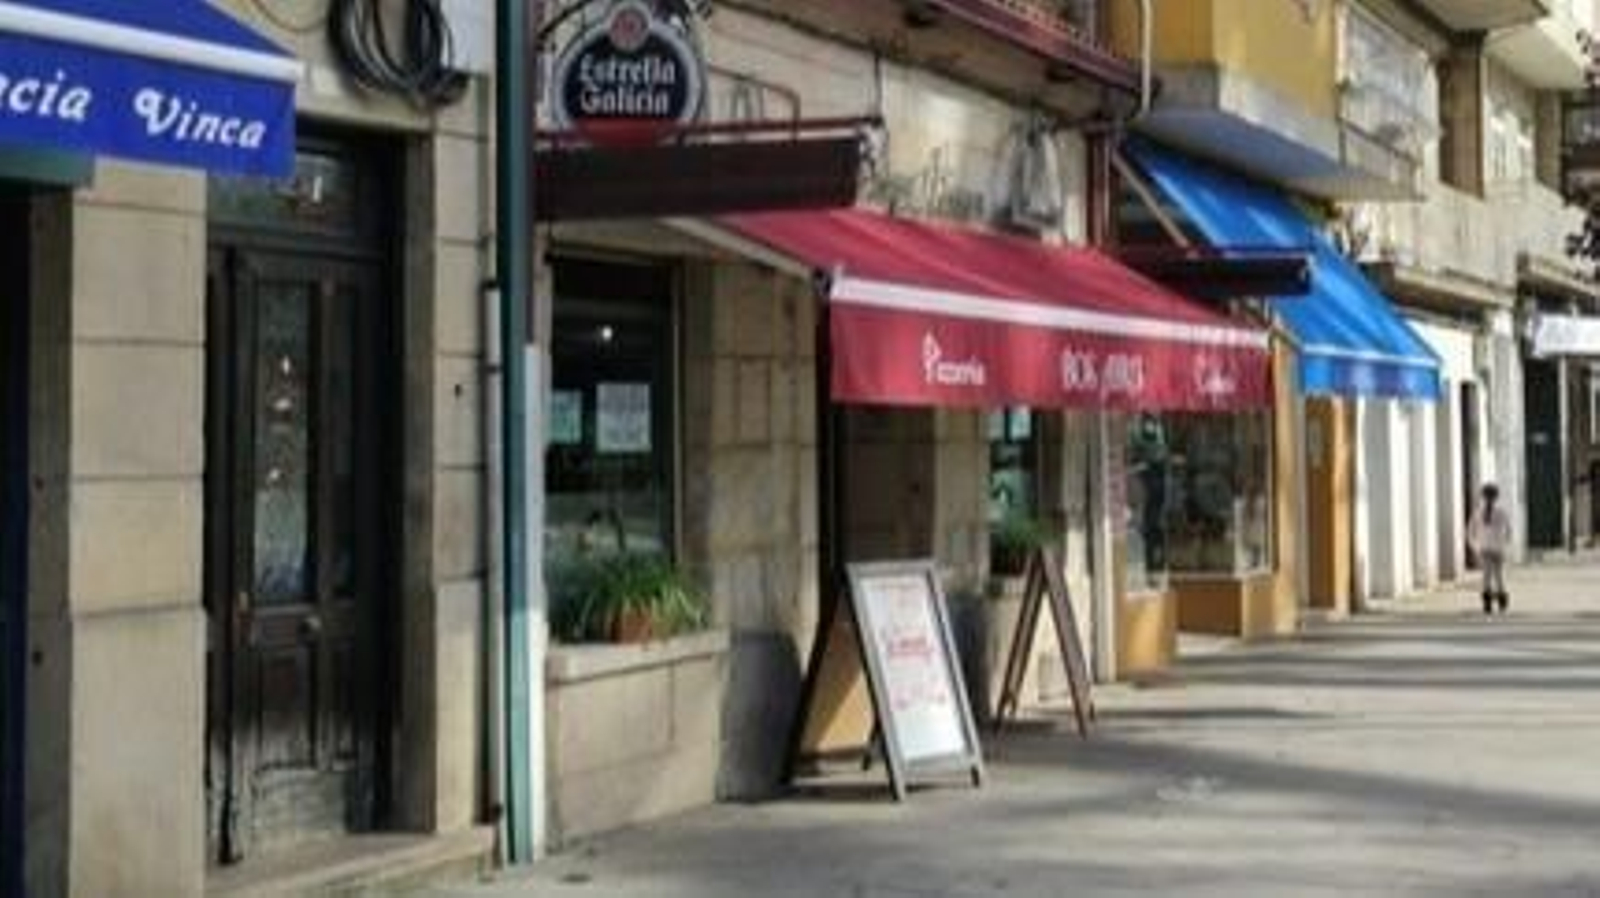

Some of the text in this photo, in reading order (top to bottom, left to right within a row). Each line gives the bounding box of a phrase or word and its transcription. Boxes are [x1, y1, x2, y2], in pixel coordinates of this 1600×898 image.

[580, 53, 676, 84] Estrella
[580, 82, 670, 114] Galicia
[134, 87, 266, 148] Vinca
